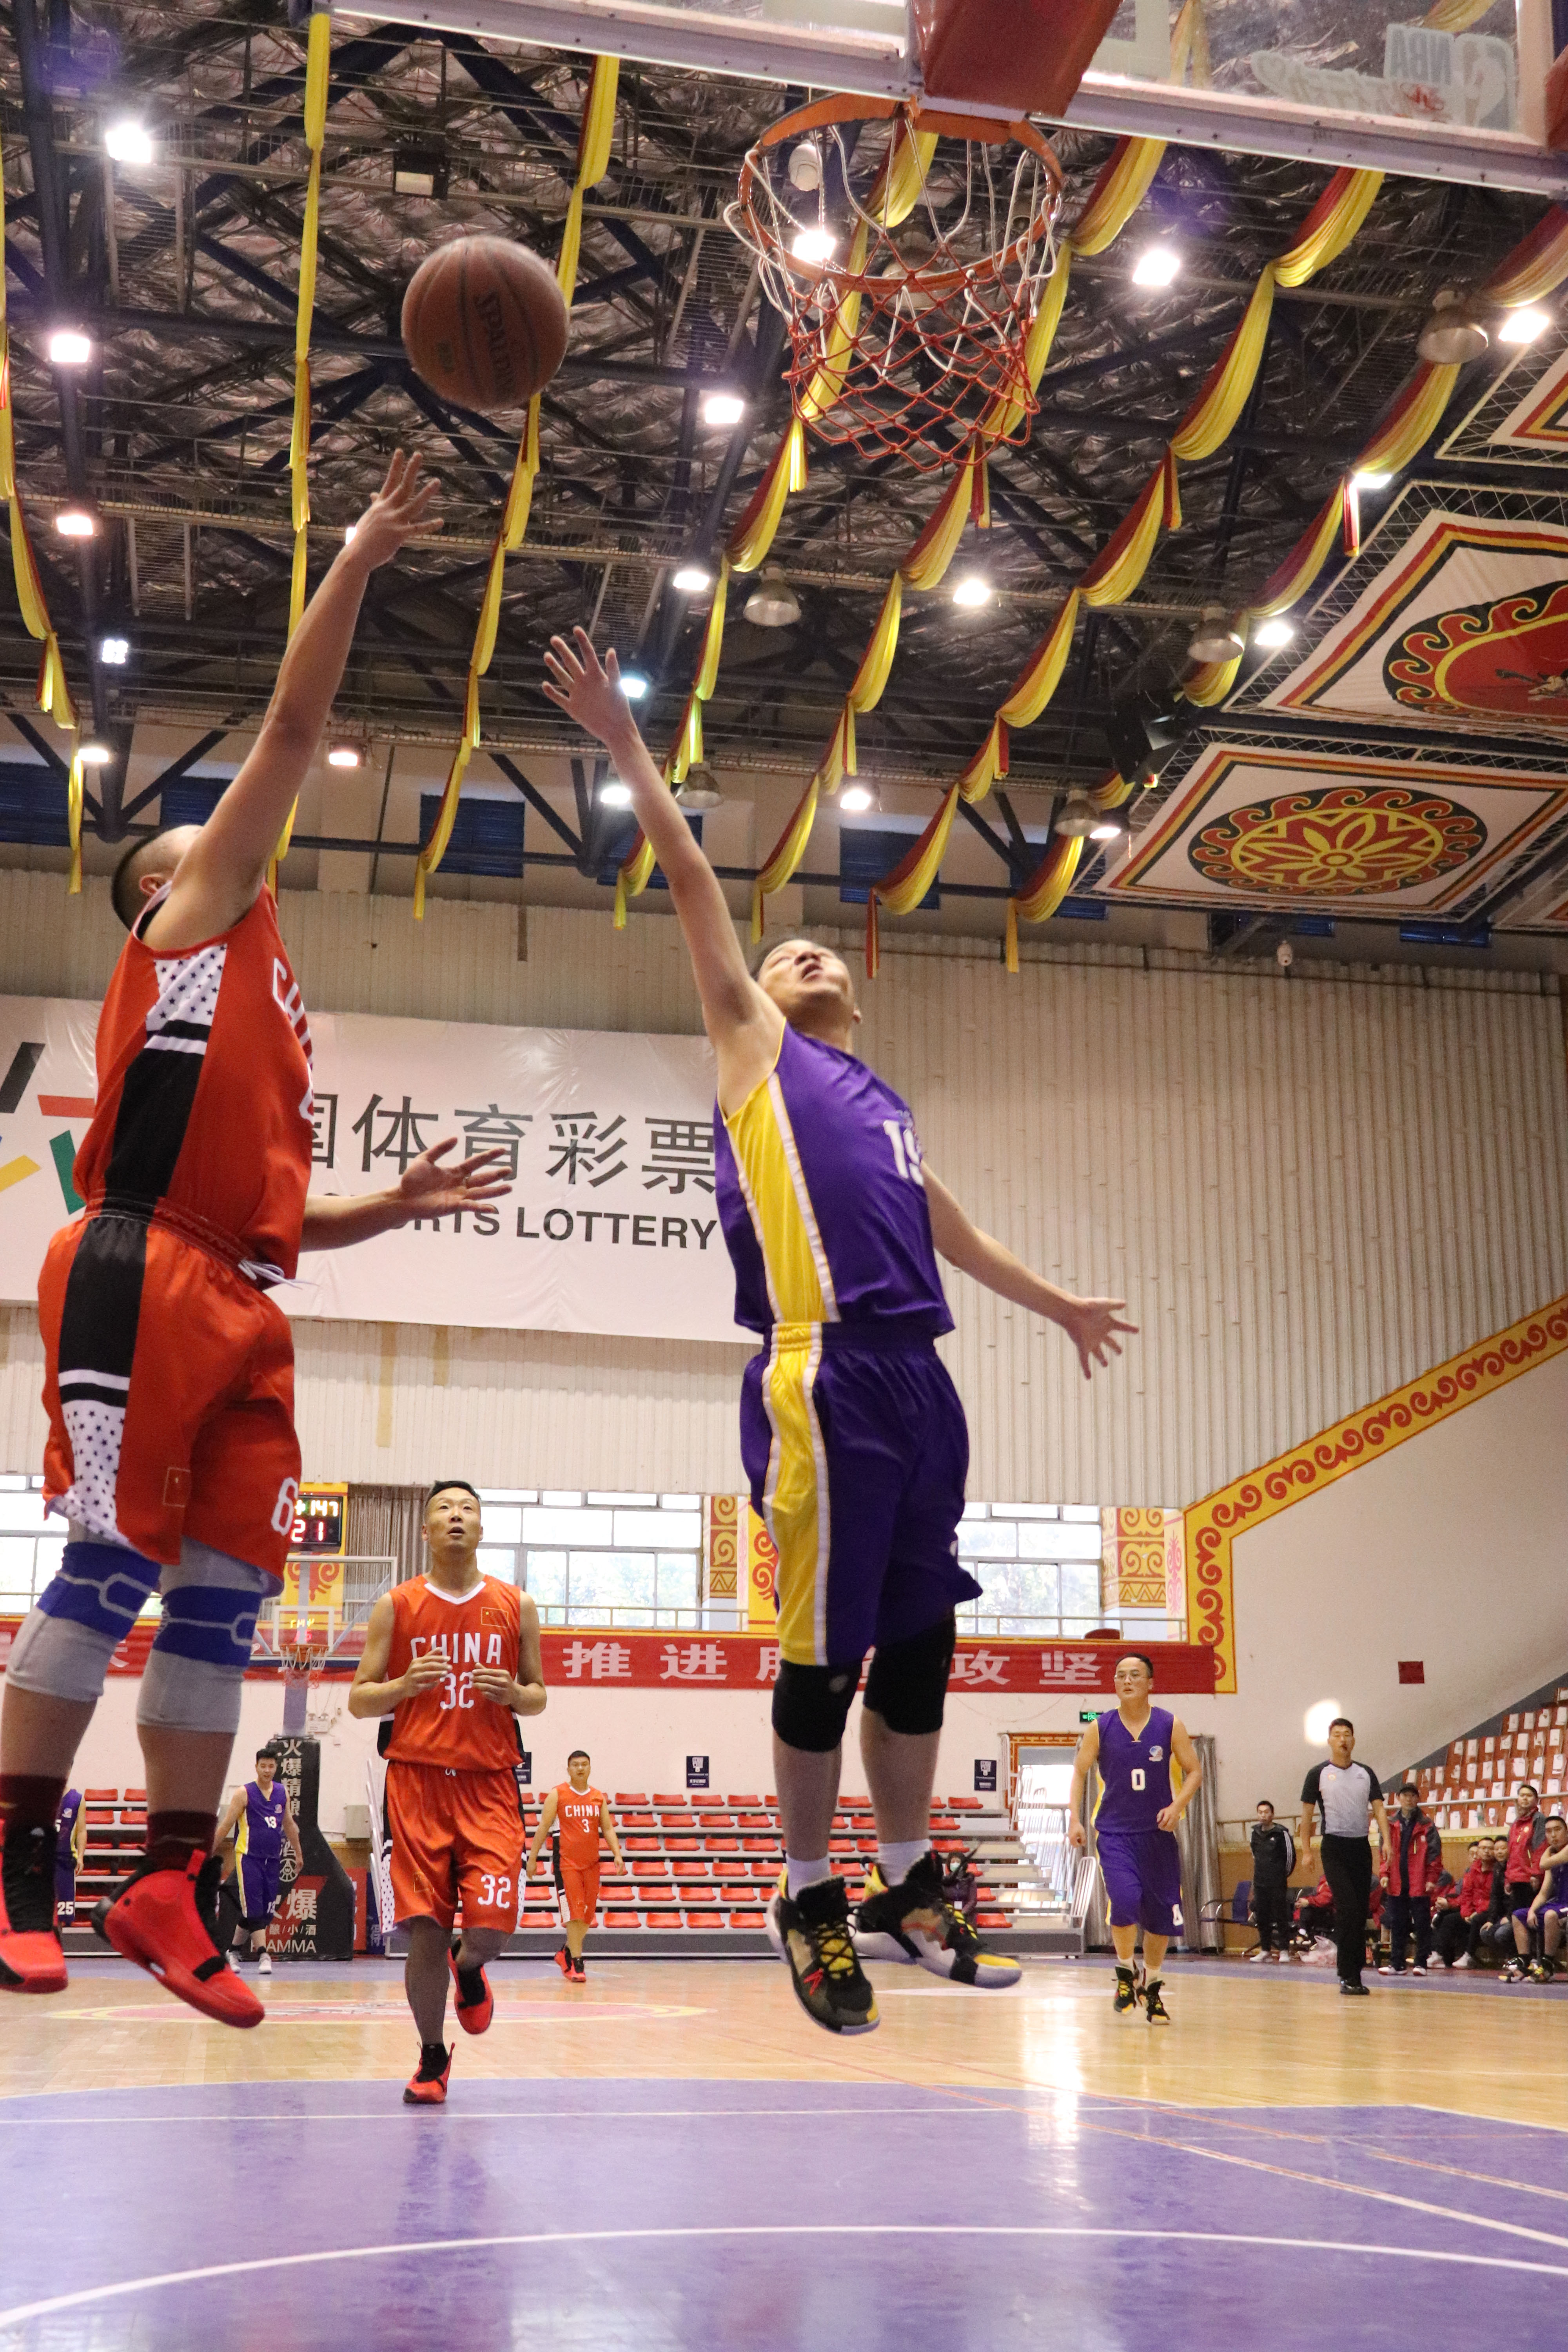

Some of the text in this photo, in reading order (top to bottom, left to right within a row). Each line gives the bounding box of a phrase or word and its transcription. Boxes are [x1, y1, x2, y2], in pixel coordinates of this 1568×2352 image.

[516, 1207, 717, 1250] LOTTERY
[271, 1477, 298, 1535] 6
[410, 1633, 501, 1665] CHINA
[440, 1671, 474, 1710] 32
[1131, 1768, 1145, 1790] 0
[565, 1805, 600, 1817] CHINA
[55, 1819, 62, 1832] 5
[264, 1816, 277, 1829] 13
[582, 1818, 590, 1833] 3
[478, 1874, 511, 1909] 32
[57, 1901, 74, 1915] 25
[250, 1940, 317, 1953] AMMA
